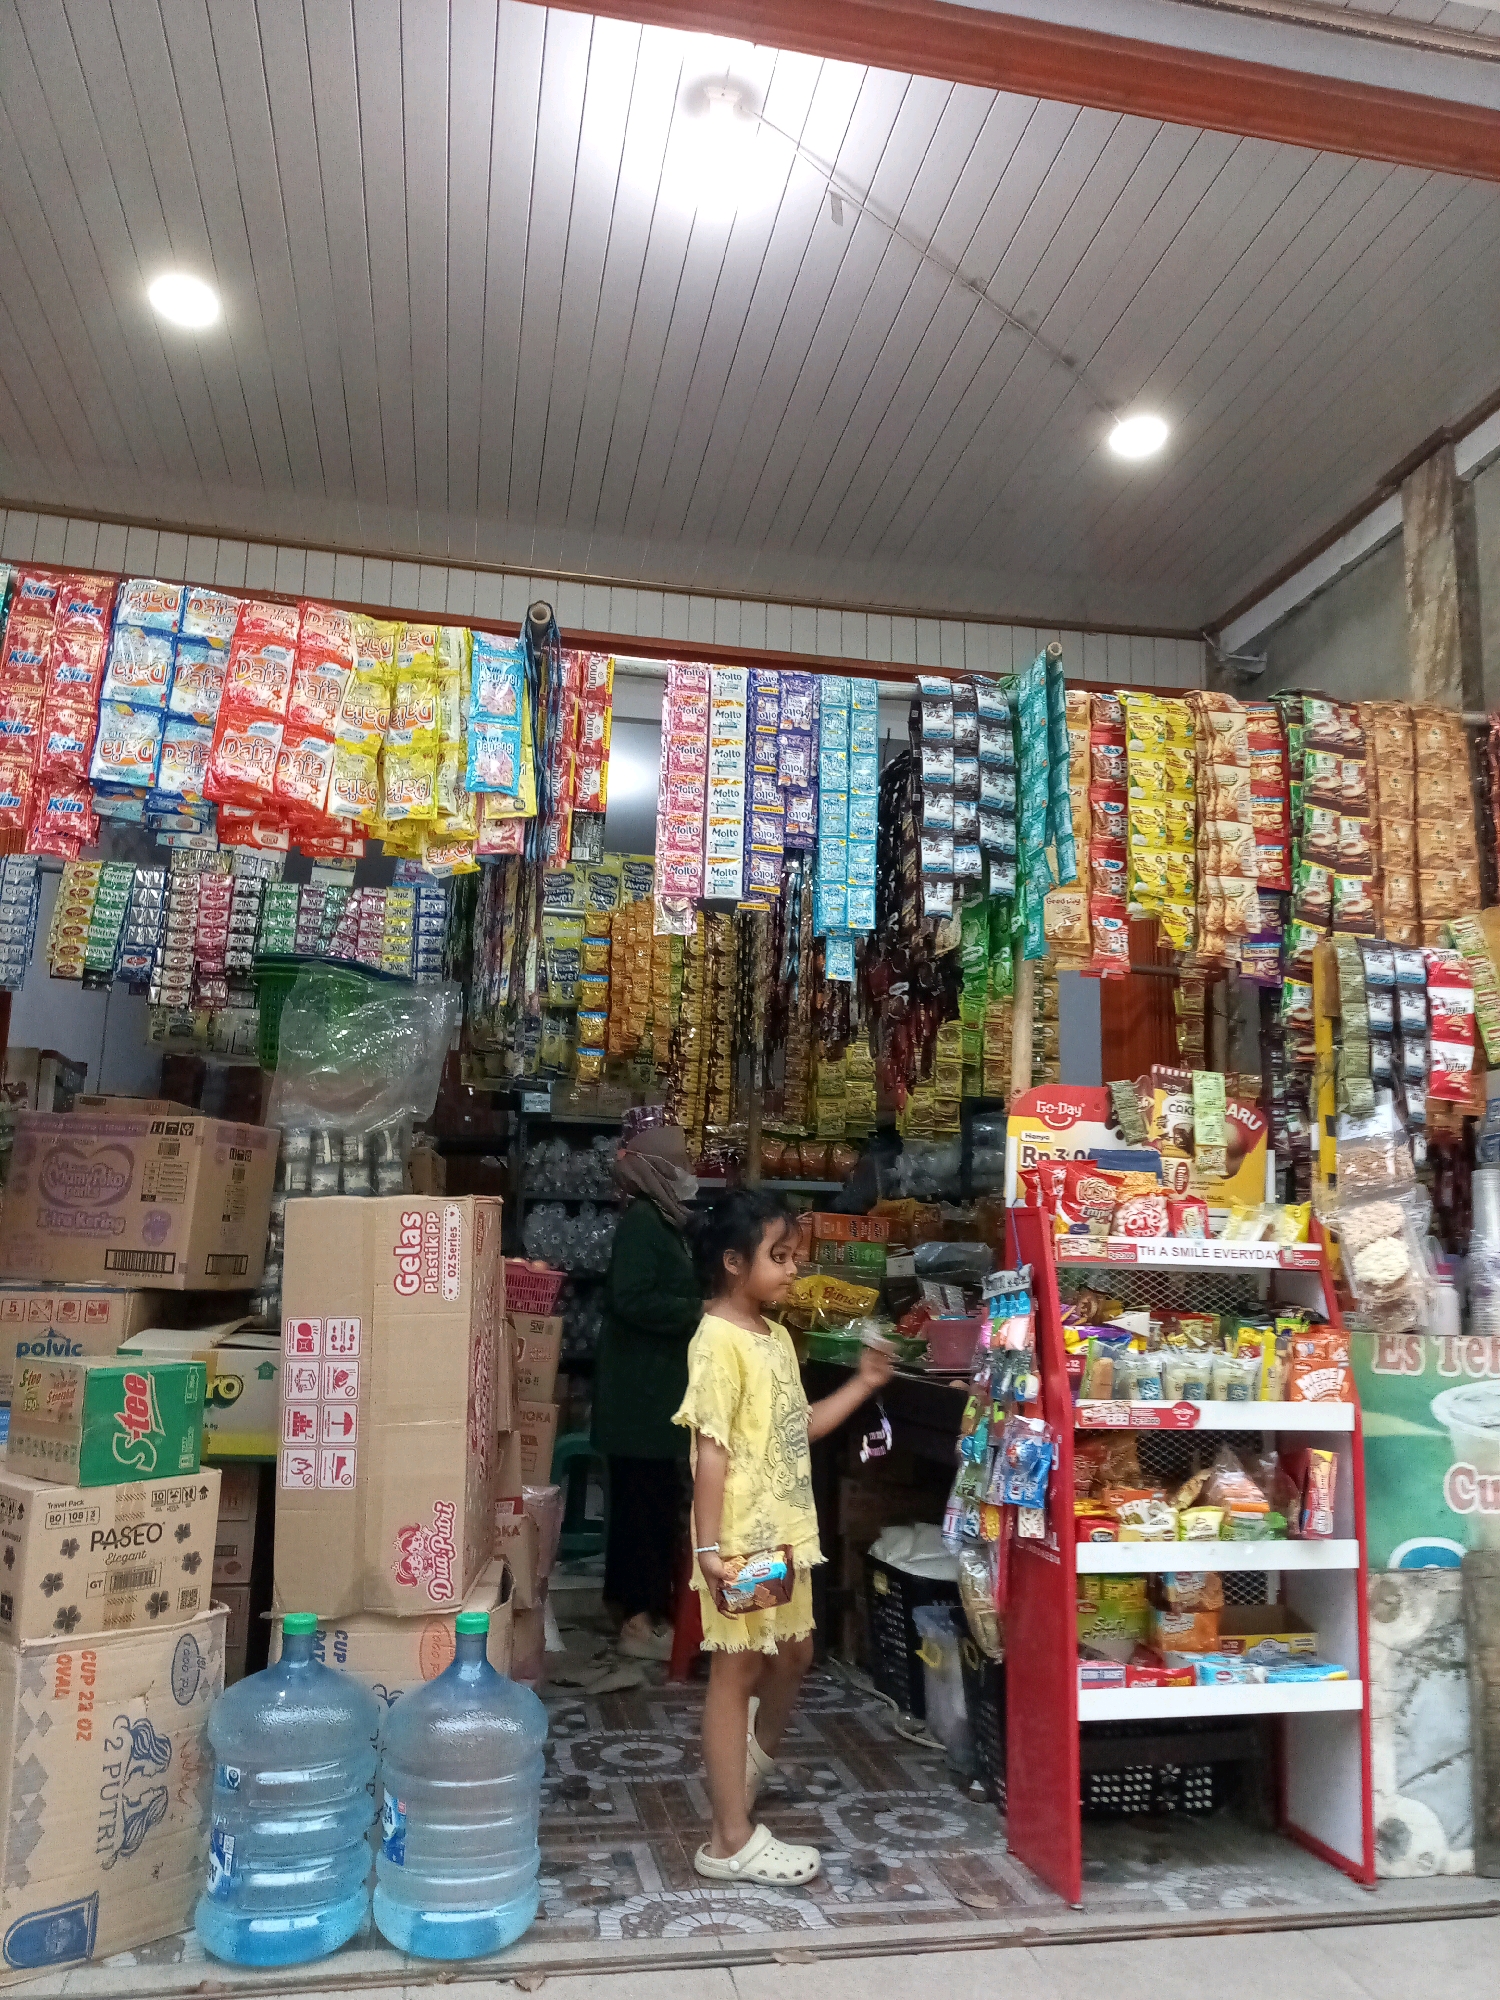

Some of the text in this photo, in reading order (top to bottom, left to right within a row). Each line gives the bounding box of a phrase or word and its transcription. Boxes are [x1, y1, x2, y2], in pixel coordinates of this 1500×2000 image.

[67, 602, 102, 616] Klin
[8, 648, 42, 665] Klin
[57, 666, 92, 683] Klin
[235, 657, 287, 683] Daia
[587, 658, 600, 690] Downy
[678, 667, 704, 676] Molto
[717, 671, 742, 681] Molto
[295, 675, 341, 701] Daia
[677, 705, 704, 715] Molto
[715, 710, 741, 719] Molto
[783, 708, 810, 720] Molto
[343, 705, 390, 732] Daia
[583, 713, 597, 747] Downy
[222, 737, 277, 760] Daia
[477, 741, 514, 755] Dewangi
[676, 745, 702, 754] Molto
[714, 749, 740, 758] Molto
[277, 751, 325, 776] Daia
[781, 764, 808, 776] Molto
[579, 767, 593, 801] Downy
[674, 784, 700, 794] Molto
[0, 792, 20, 806] lin
[713, 788, 739, 797] Molto
[755, 793, 783, 803] Molto
[47, 798, 84, 813] Klin
[788, 811, 816, 822] Molto
[672, 825, 699, 834] Molto
[712, 828, 738, 838] Molto
[754, 831, 784, 844] Molto
[9, 868, 32, 876] CLEAR
[670, 865, 697, 875] Molto
[711, 867, 737, 876] Molto
[753, 871, 778, 882] Molto
[5, 888, 29, 896] CLEAR
[626, 881, 650, 891] Awet
[0, 966, 18, 974] LEAR
[553, 972, 578, 981] Awet
[1036, 1100, 1082, 1117] Go-Day
[1226, 1103, 1262, 1131] ARU
[1025, 1133, 1050, 1141] Hanya
[394, 1211, 423, 1296] Gelas
[424, 1211, 440, 1294] Plastik PP
[447, 1226, 458, 1278] OZ Series
[1139, 1246, 1156, 1256] TH
[1161, 1246, 1168, 1256] A
[1172, 1247, 1210, 1258] SMILE
[1214, 1248, 1280, 1261] EVERYDAY
[9, 1301, 17, 1312] 5
[530, 1321, 544, 1333] SNI
[17, 1339, 83, 1358] polvic
[1371, 1335, 1426, 1376] Es
[206, 1377, 240, 1399] ro
[113, 1372, 158, 1472] S-tee
[520, 1410, 550, 1423] IOKA
[153, 1492, 164, 1500] 10
[47, 1501, 67, 1509] Travel
[49, 1514, 61, 1523] 80
[69, 1512, 83, 1521] 108
[90, 1523, 163, 1552] PASEO
[105, 1550, 147, 1565] Elegant
[428, 1500, 456, 1602] Dua Putri
[90, 1580, 103, 1589] GT
[333, 1630, 348, 1663] CUP
[54, 1653, 73, 1701] OVAL
[76, 1651, 97, 1742] CUP 22 OZ
[95, 1736, 125, 1854] 2 PUTRI
